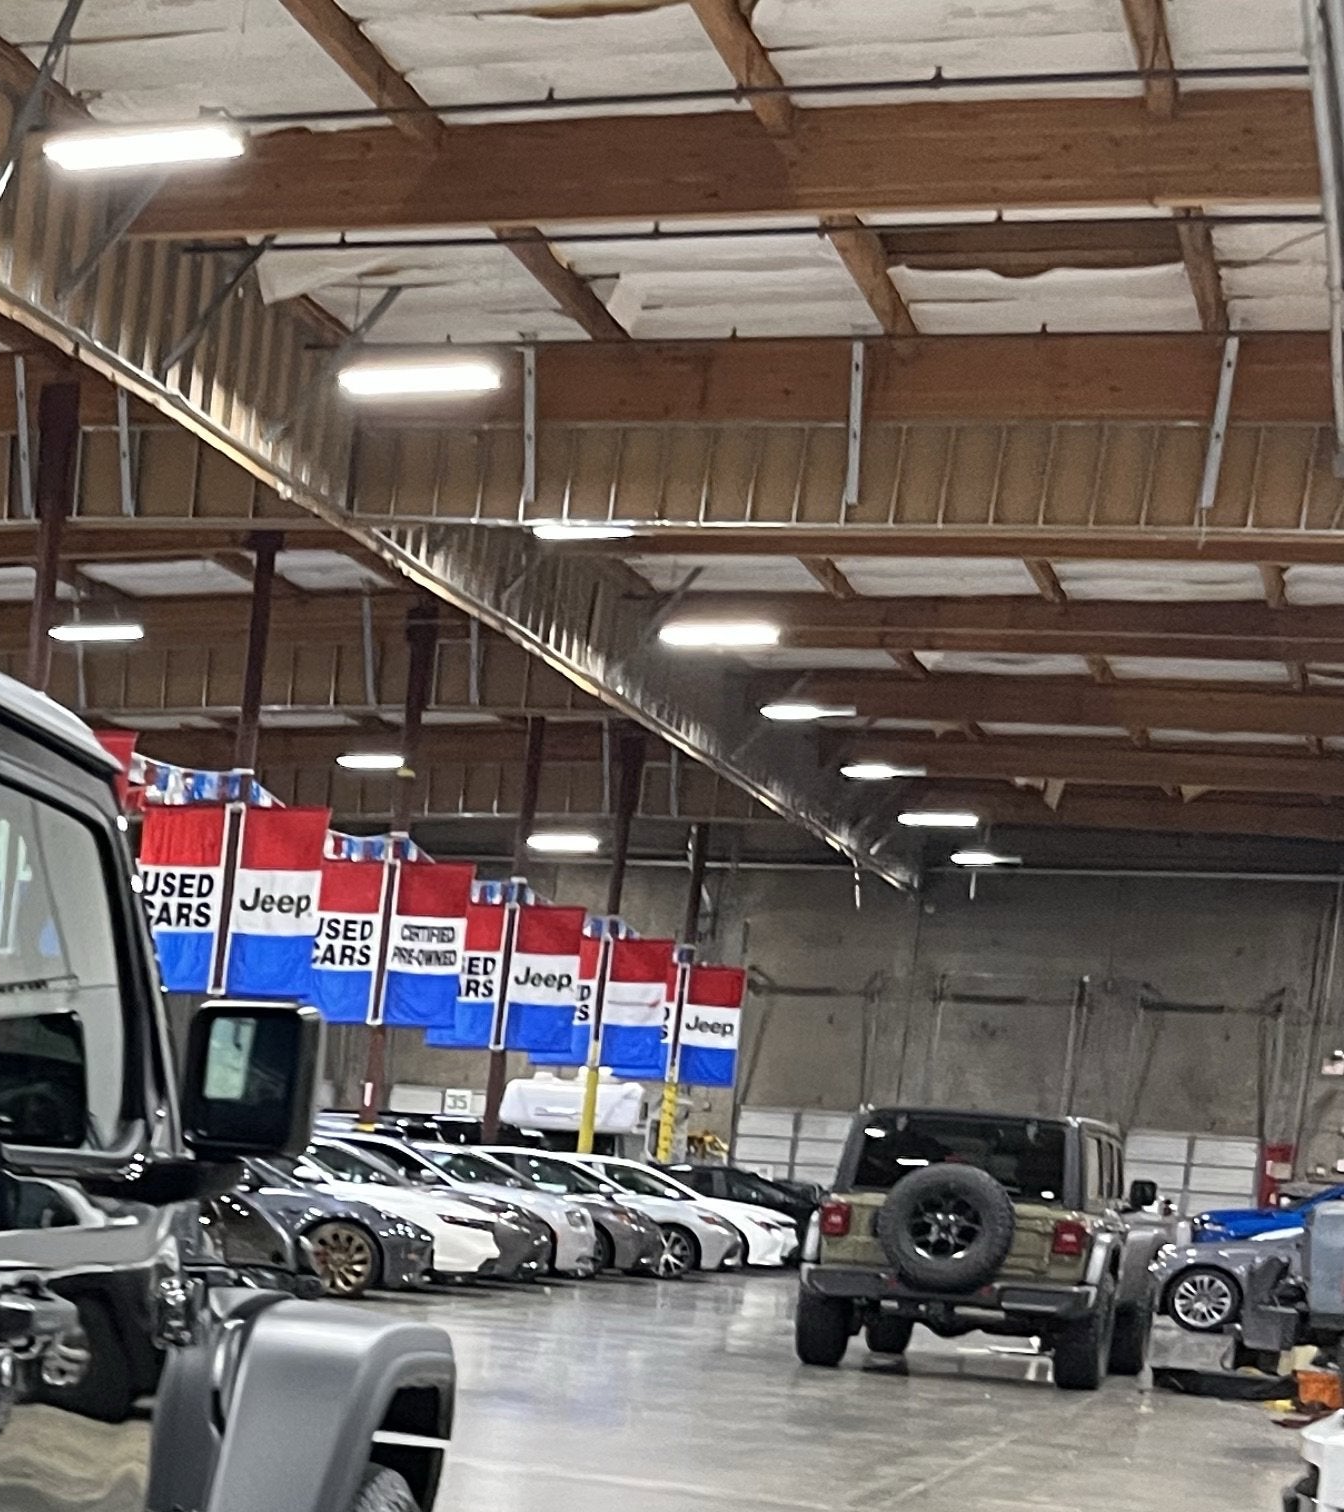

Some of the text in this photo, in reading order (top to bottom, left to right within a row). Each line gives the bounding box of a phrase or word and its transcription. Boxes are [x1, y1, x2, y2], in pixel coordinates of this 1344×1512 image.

[143, 871, 214, 898] USED
[144, 900, 211, 927] CARS
[239, 887, 312, 918] Jeep
[466, 956, 497, 976] ED
[464, 978, 494, 998] RS
[514, 966, 572, 992] Jeep
[685, 1016, 734, 1037] Jeep
[446, 1094, 468, 1110] 35
